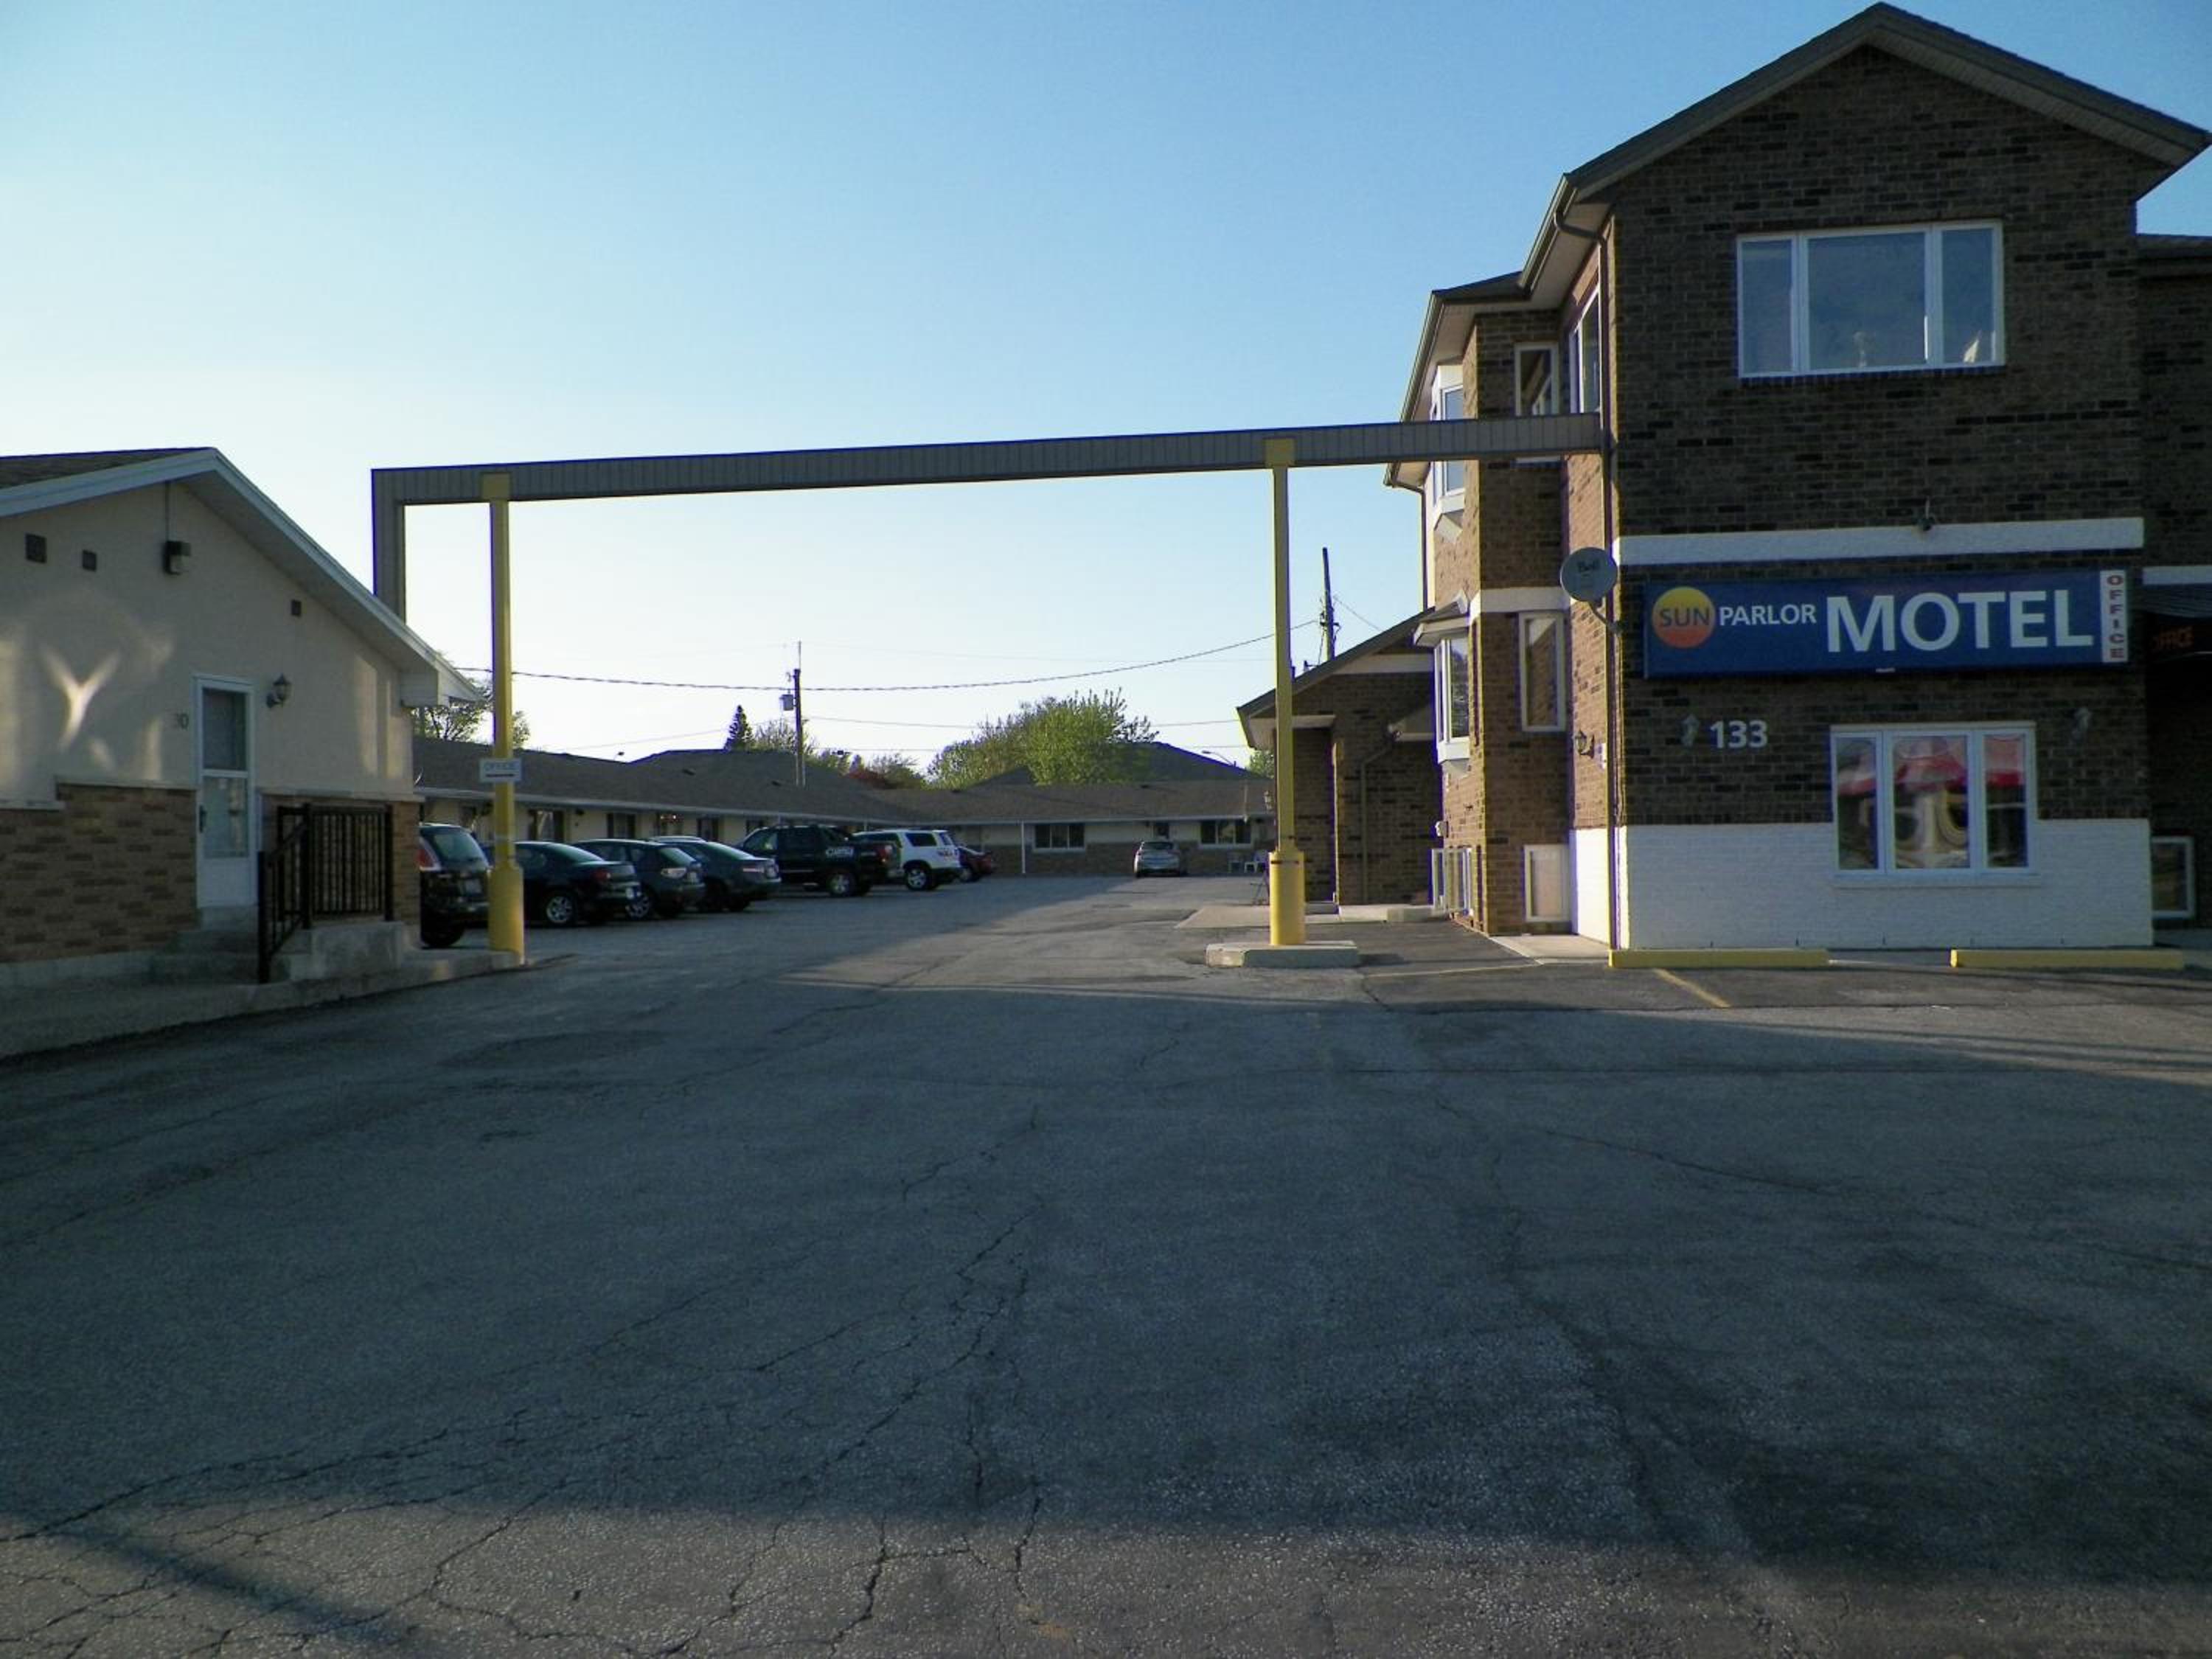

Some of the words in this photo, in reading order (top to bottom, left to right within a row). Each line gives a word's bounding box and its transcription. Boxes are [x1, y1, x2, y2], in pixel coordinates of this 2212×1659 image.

[1660, 607, 1709, 627] SUN
[1719, 604, 1817, 625] PARLOR
[1826, 589, 2094, 653] MOTEL
[2107, 575, 2124, 658] OFFICE
[1710, 720, 1769, 749] 133
